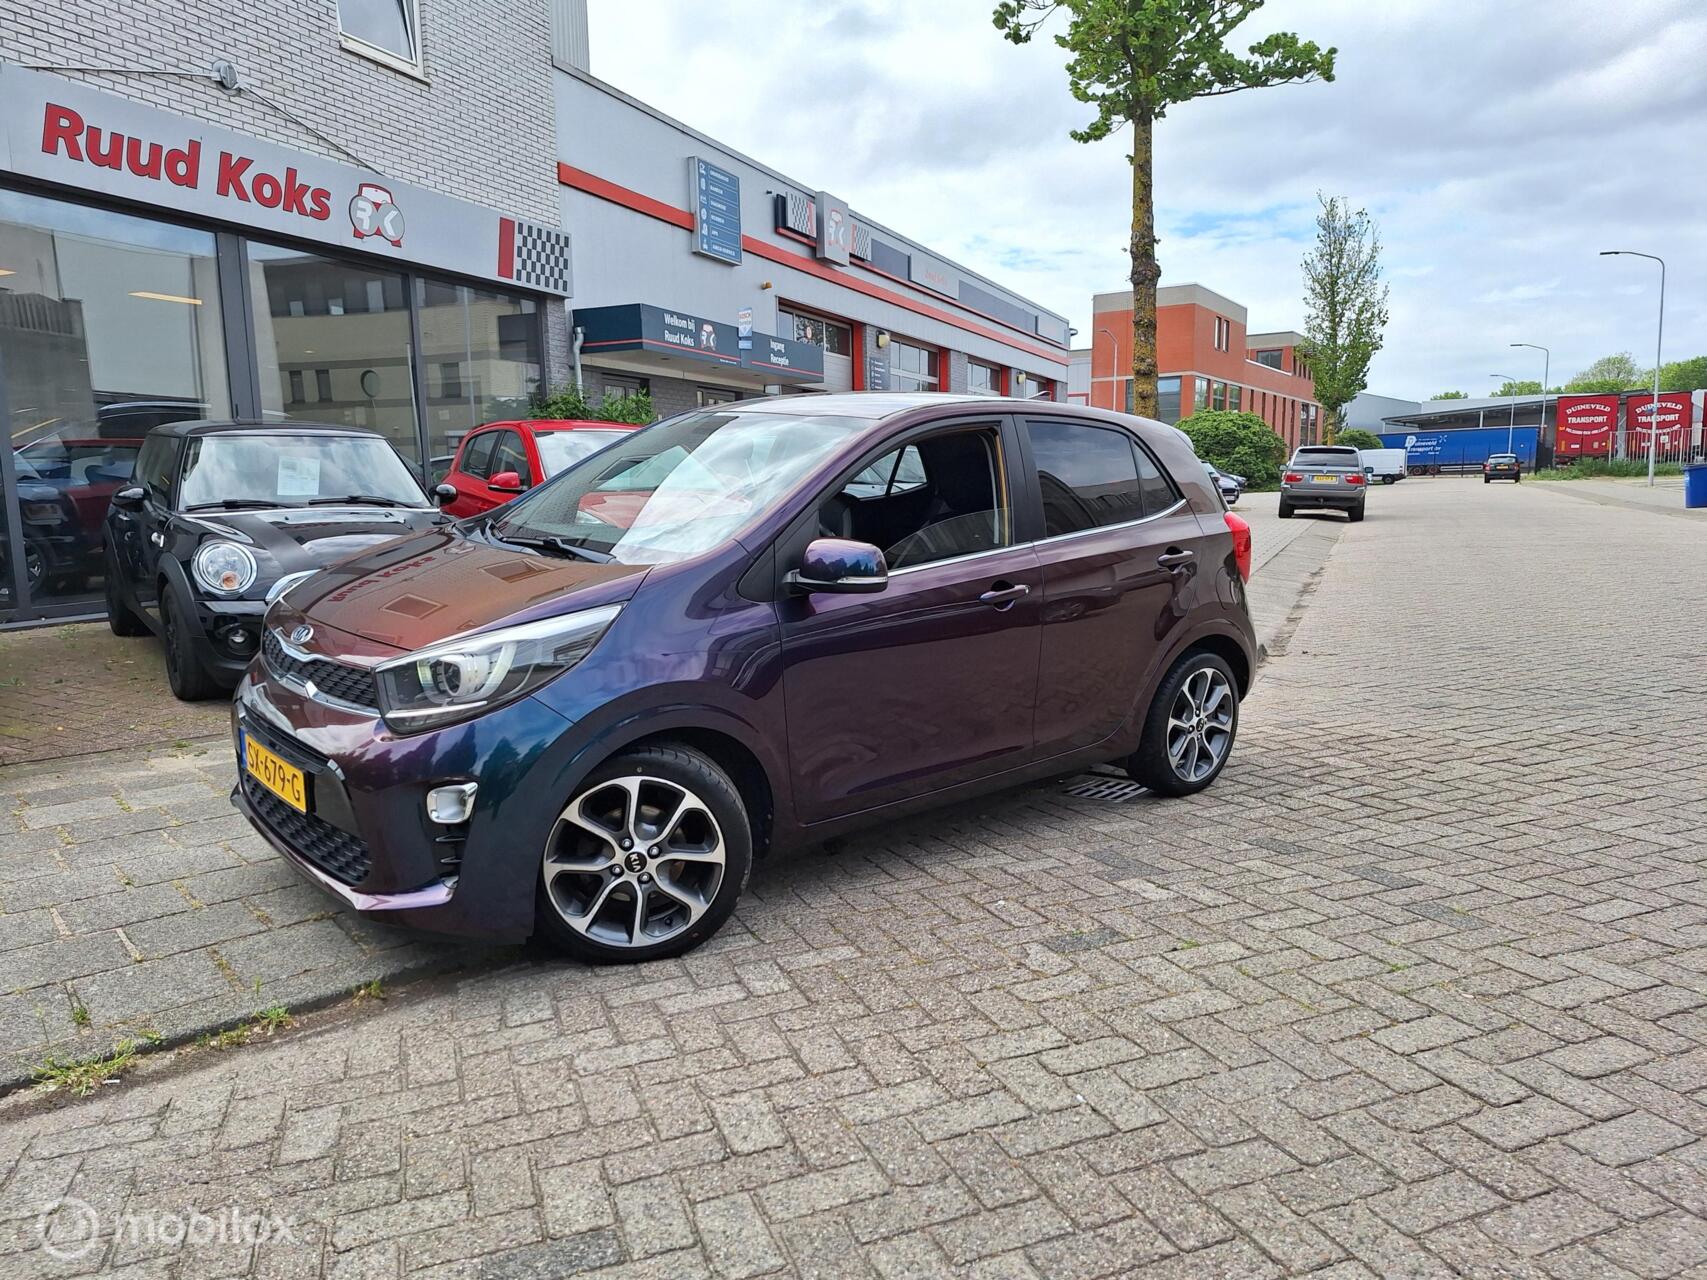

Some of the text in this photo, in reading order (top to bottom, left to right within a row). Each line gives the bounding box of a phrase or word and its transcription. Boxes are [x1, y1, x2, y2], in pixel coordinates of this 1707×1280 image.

[42, 102, 331, 221] Ruud Koks
[663, 312, 696, 332] Welkom bij
[664, 330, 695, 347] Ruud Koks
[770, 338, 785, 353] Ingang
[770, 353, 789, 367] Receptie
[1565, 403, 1611, 415] DUINEVELD
[1567, 415, 1607, 424] TRANSPORT
[247, 741, 301, 803] SX-679-G
[630, 853, 642, 872] KIA
